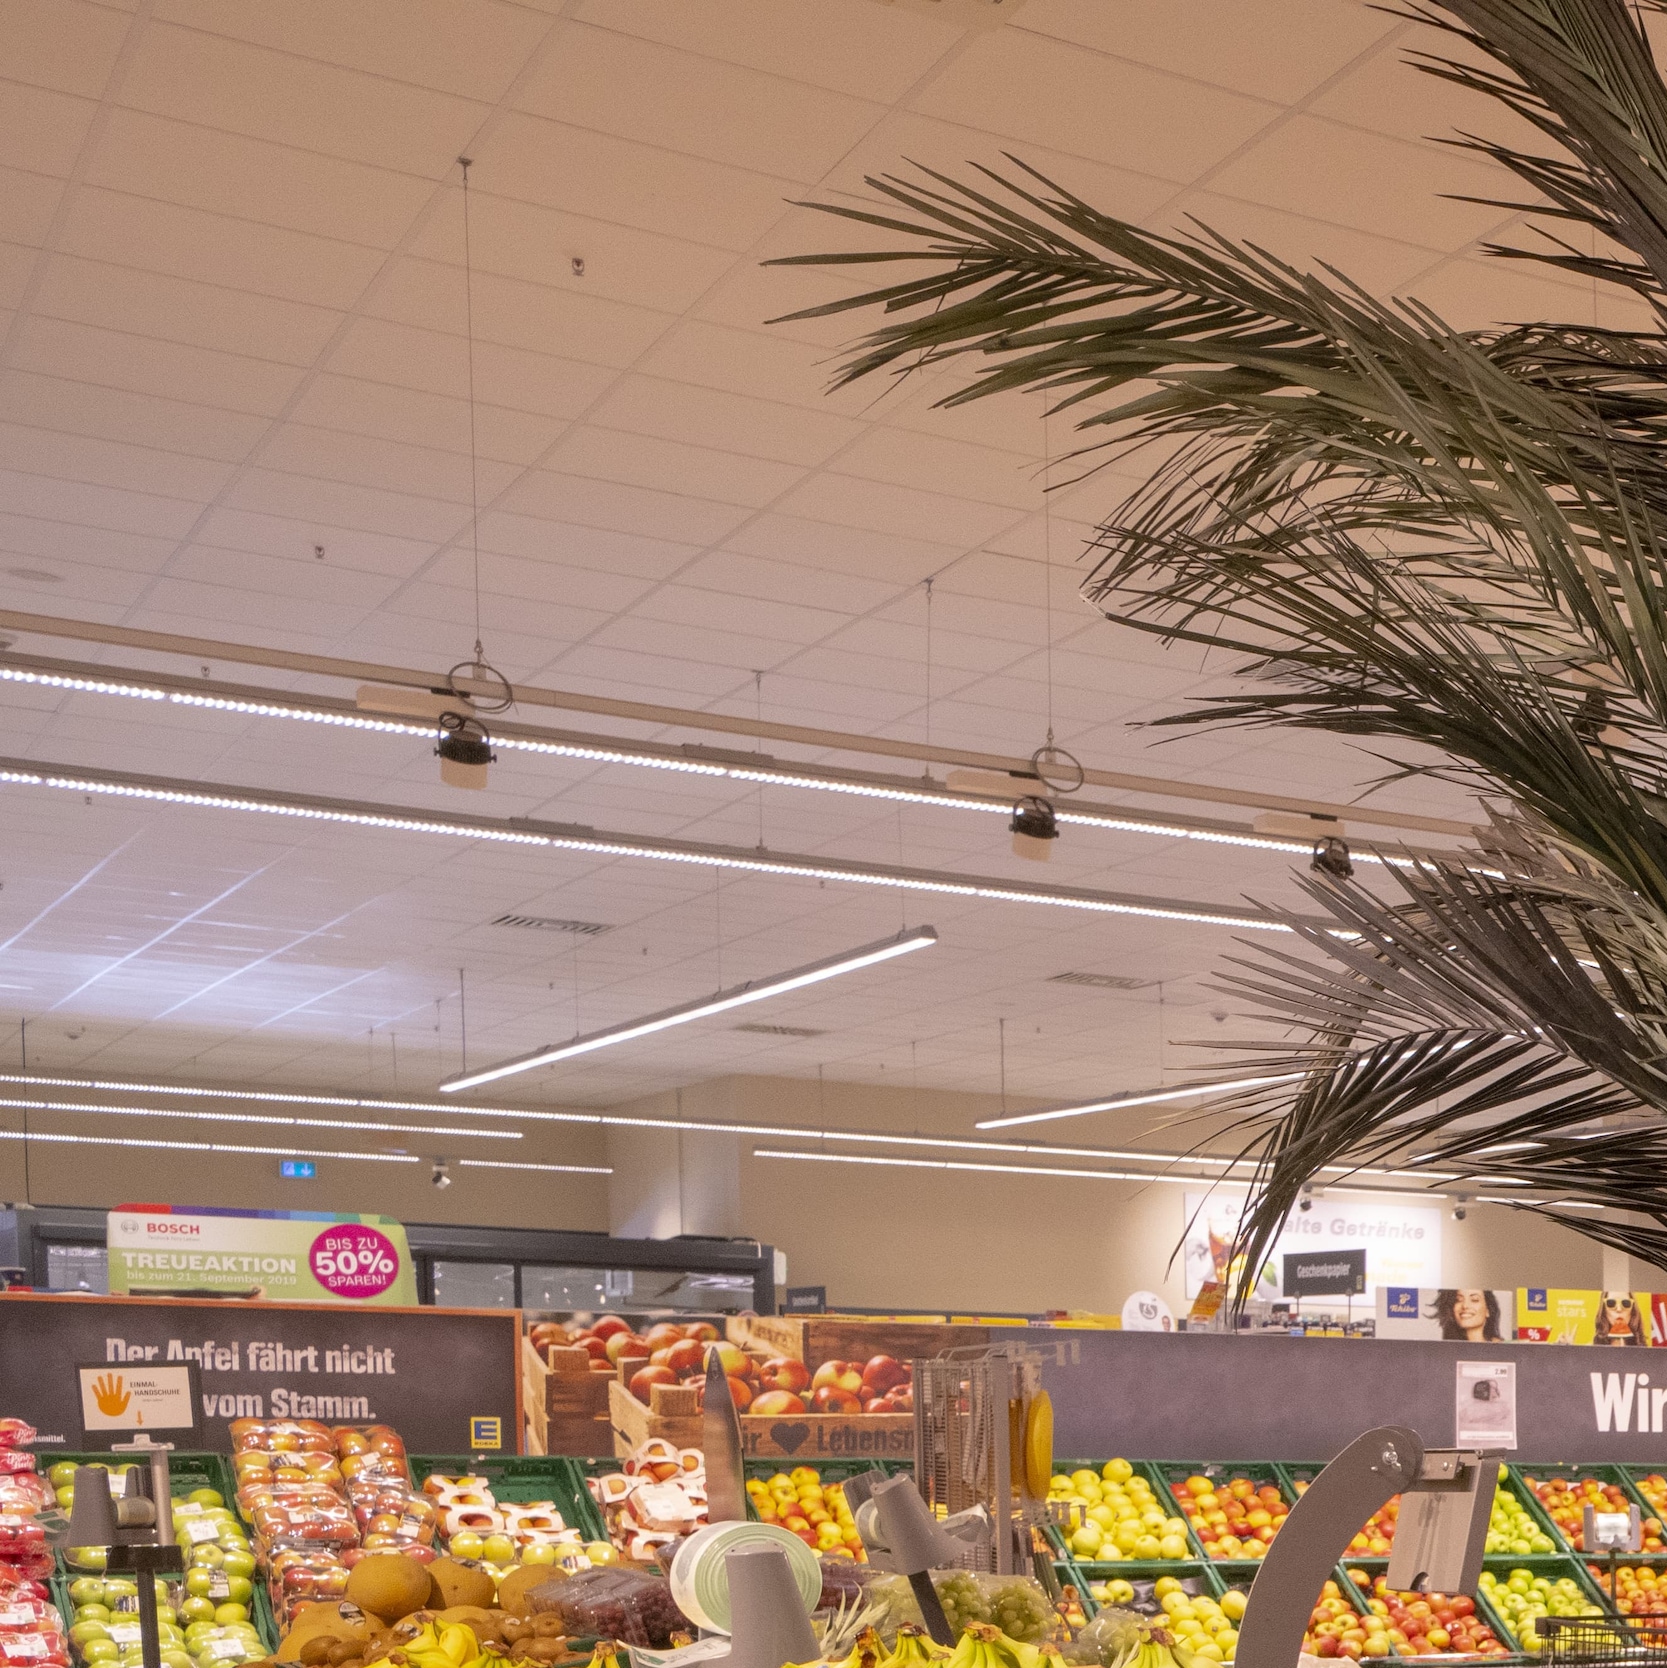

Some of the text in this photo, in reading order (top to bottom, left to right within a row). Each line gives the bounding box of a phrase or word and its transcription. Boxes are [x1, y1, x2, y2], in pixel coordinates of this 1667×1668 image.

[146, 1222, 200, 1234] BOSCH
[1284, 1217, 1425, 1240] alte Getränke
[326, 1238, 378, 1250] BIS ZU
[122, 1252, 296, 1274] TREUEAKTION
[316, 1251, 394, 1275] 50%
[127, 1271, 297, 1286] bis zum 21. September 2019
[1297, 1263, 1350, 1279] Geschenkpapier
[328, 1274, 386, 1287] SPAREN!
[1389, 1305, 1417, 1314] Tchibo
[1557, 1306, 1587, 1319] stars
[247, 1341, 319, 1374] fährt
[325, 1345, 395, 1375] nicht
[134, 1388, 181, 1396] HANDSCHUHE
[202, 1387, 376, 1419] vom Stamm.
